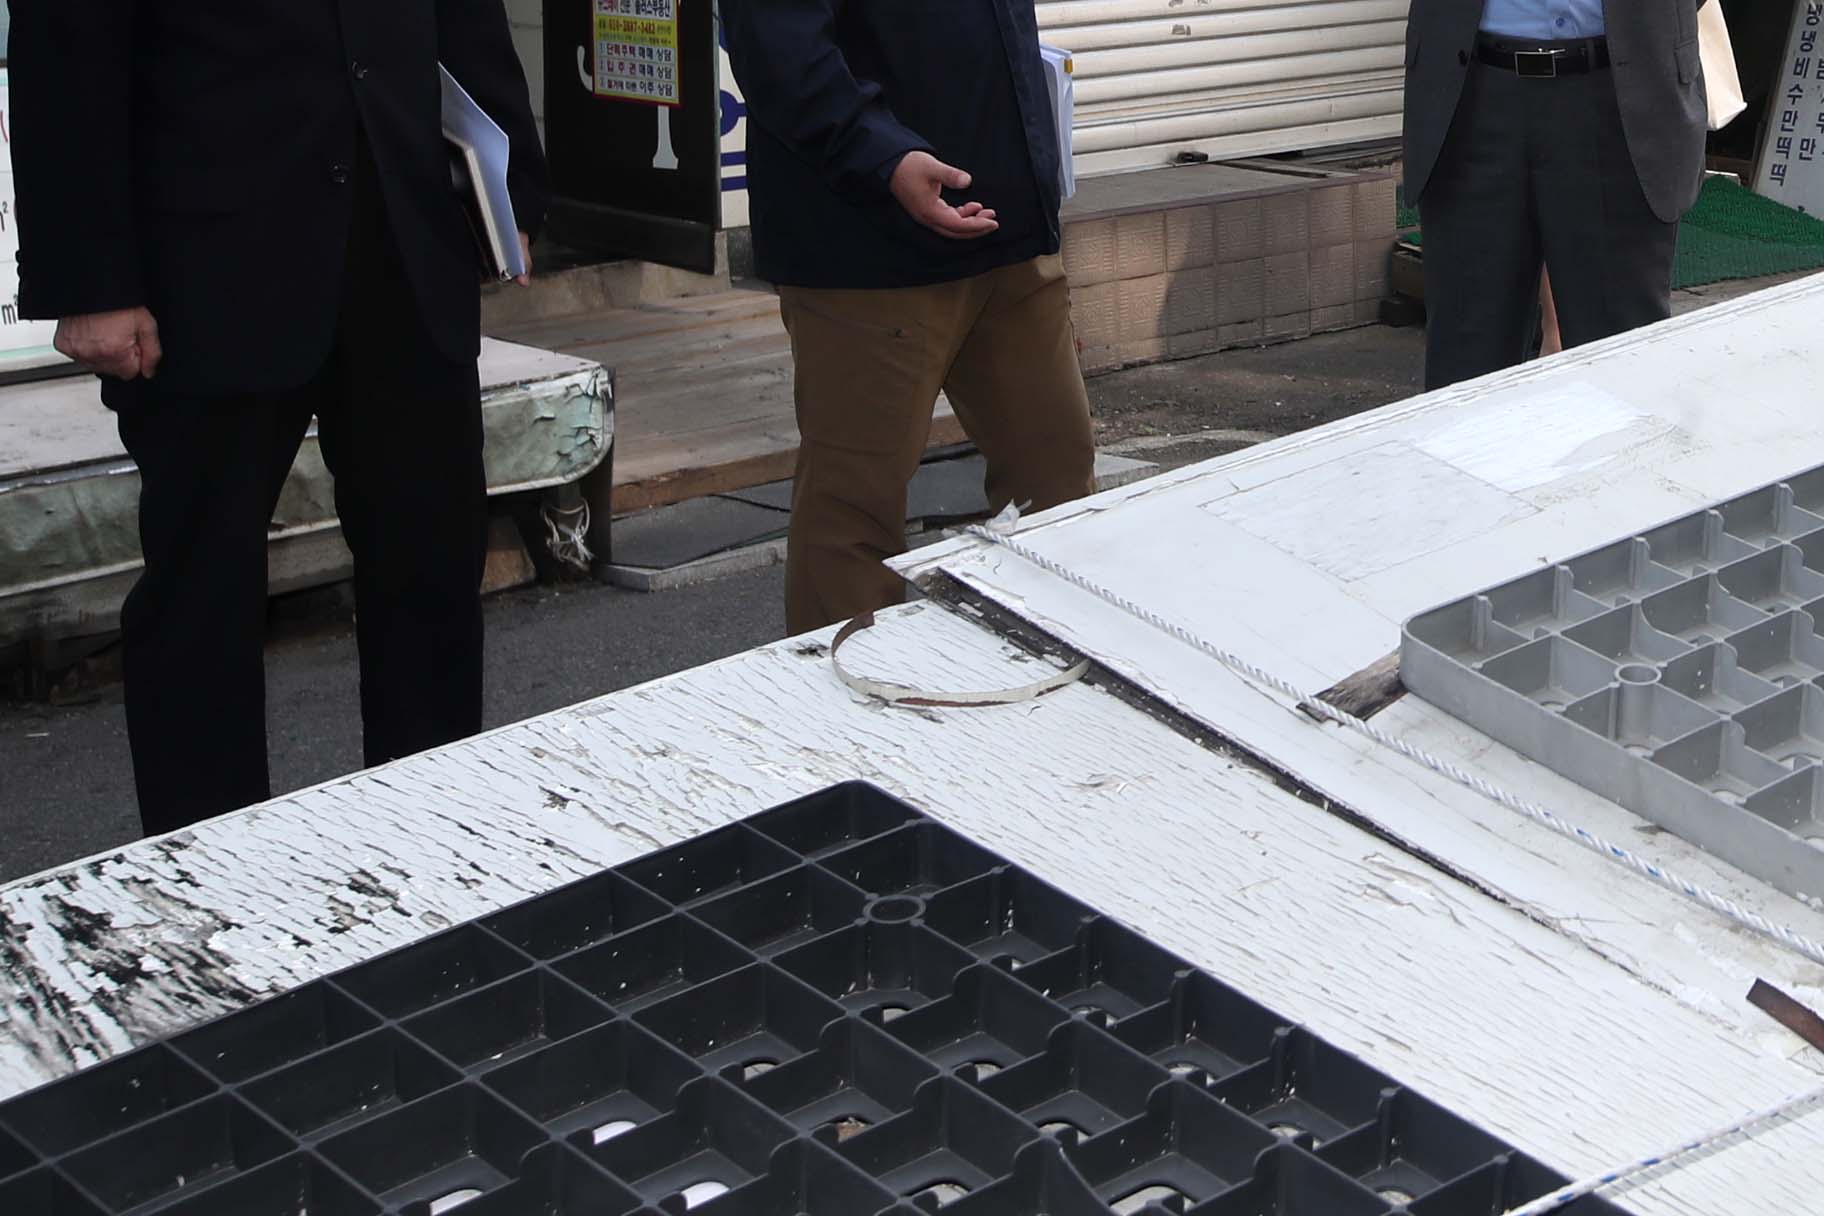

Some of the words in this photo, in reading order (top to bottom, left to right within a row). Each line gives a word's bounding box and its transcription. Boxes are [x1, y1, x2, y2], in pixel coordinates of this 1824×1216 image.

[656, 47, 672, 62] 상담
[657, 66, 672, 80] 상담
[657, 83, 672, 97] 상담
